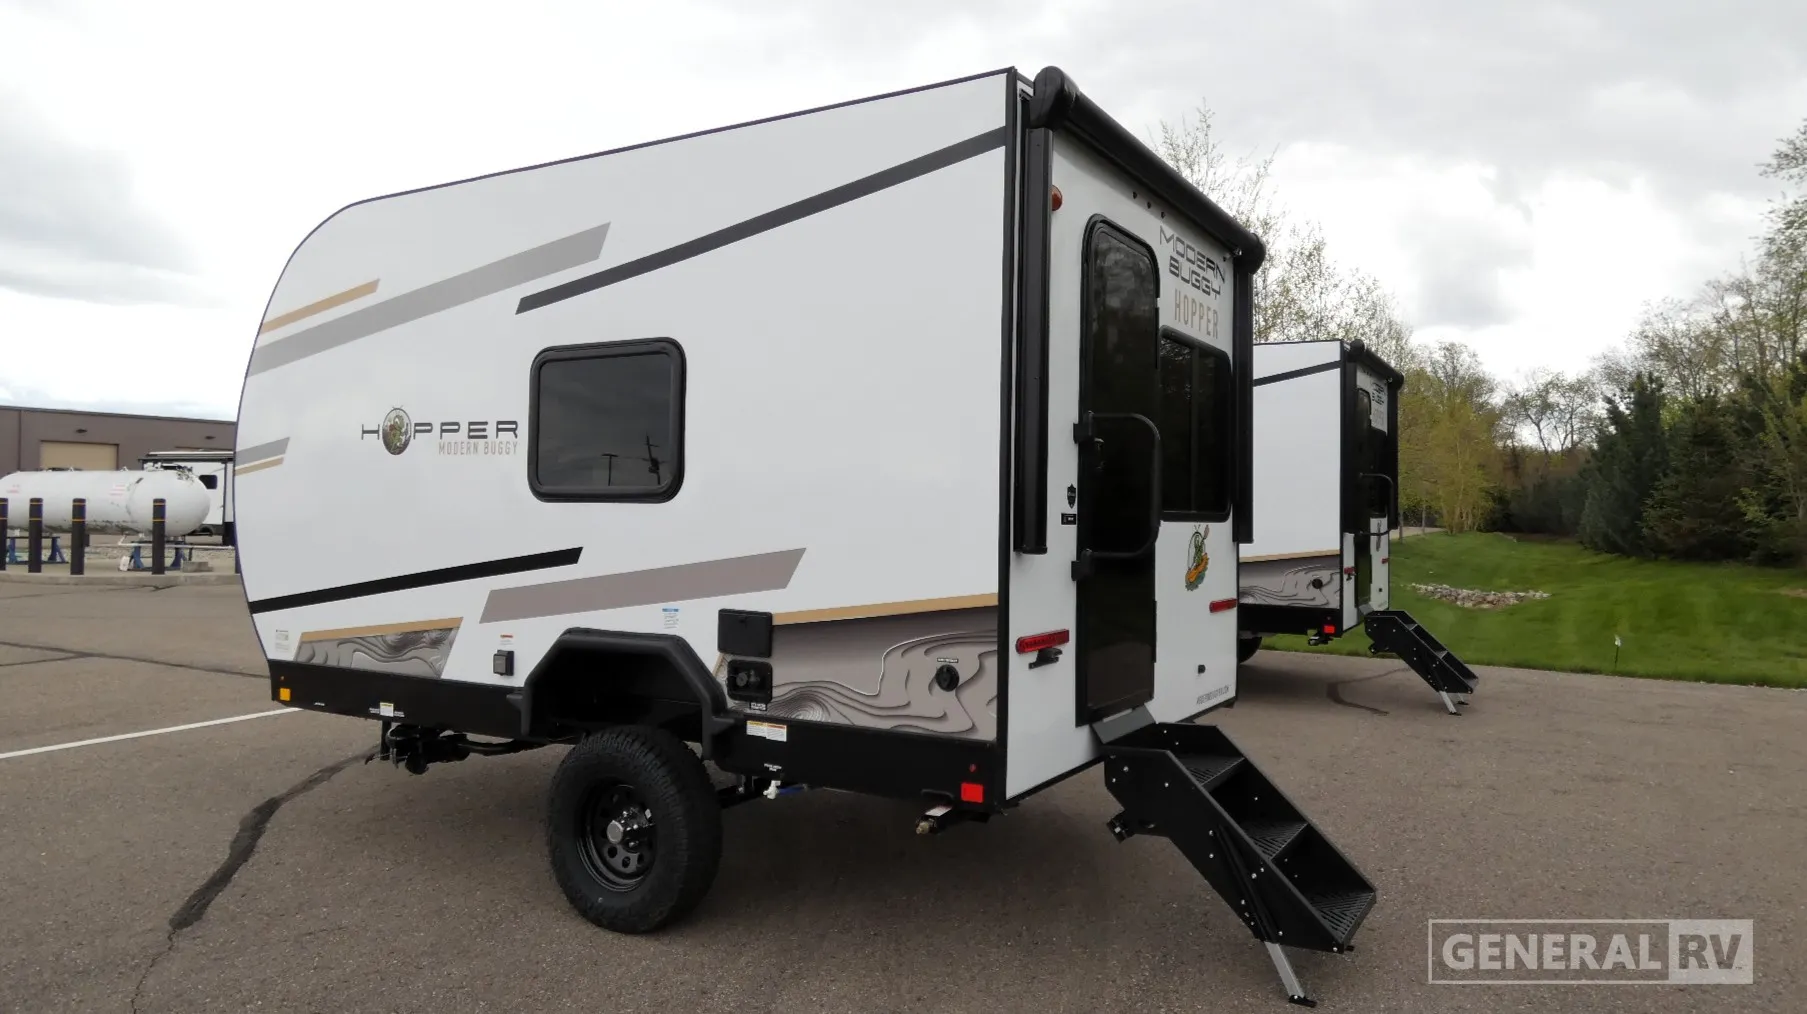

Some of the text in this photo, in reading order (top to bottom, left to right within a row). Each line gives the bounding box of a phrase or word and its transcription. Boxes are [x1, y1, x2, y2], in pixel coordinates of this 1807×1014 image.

[1160, 225, 1226, 283] MODERN
[1169, 256, 1221, 300] BUGGY
[1174, 288, 1218, 339] HOPPER
[438, 441, 518, 455] MODERN BUGGY
